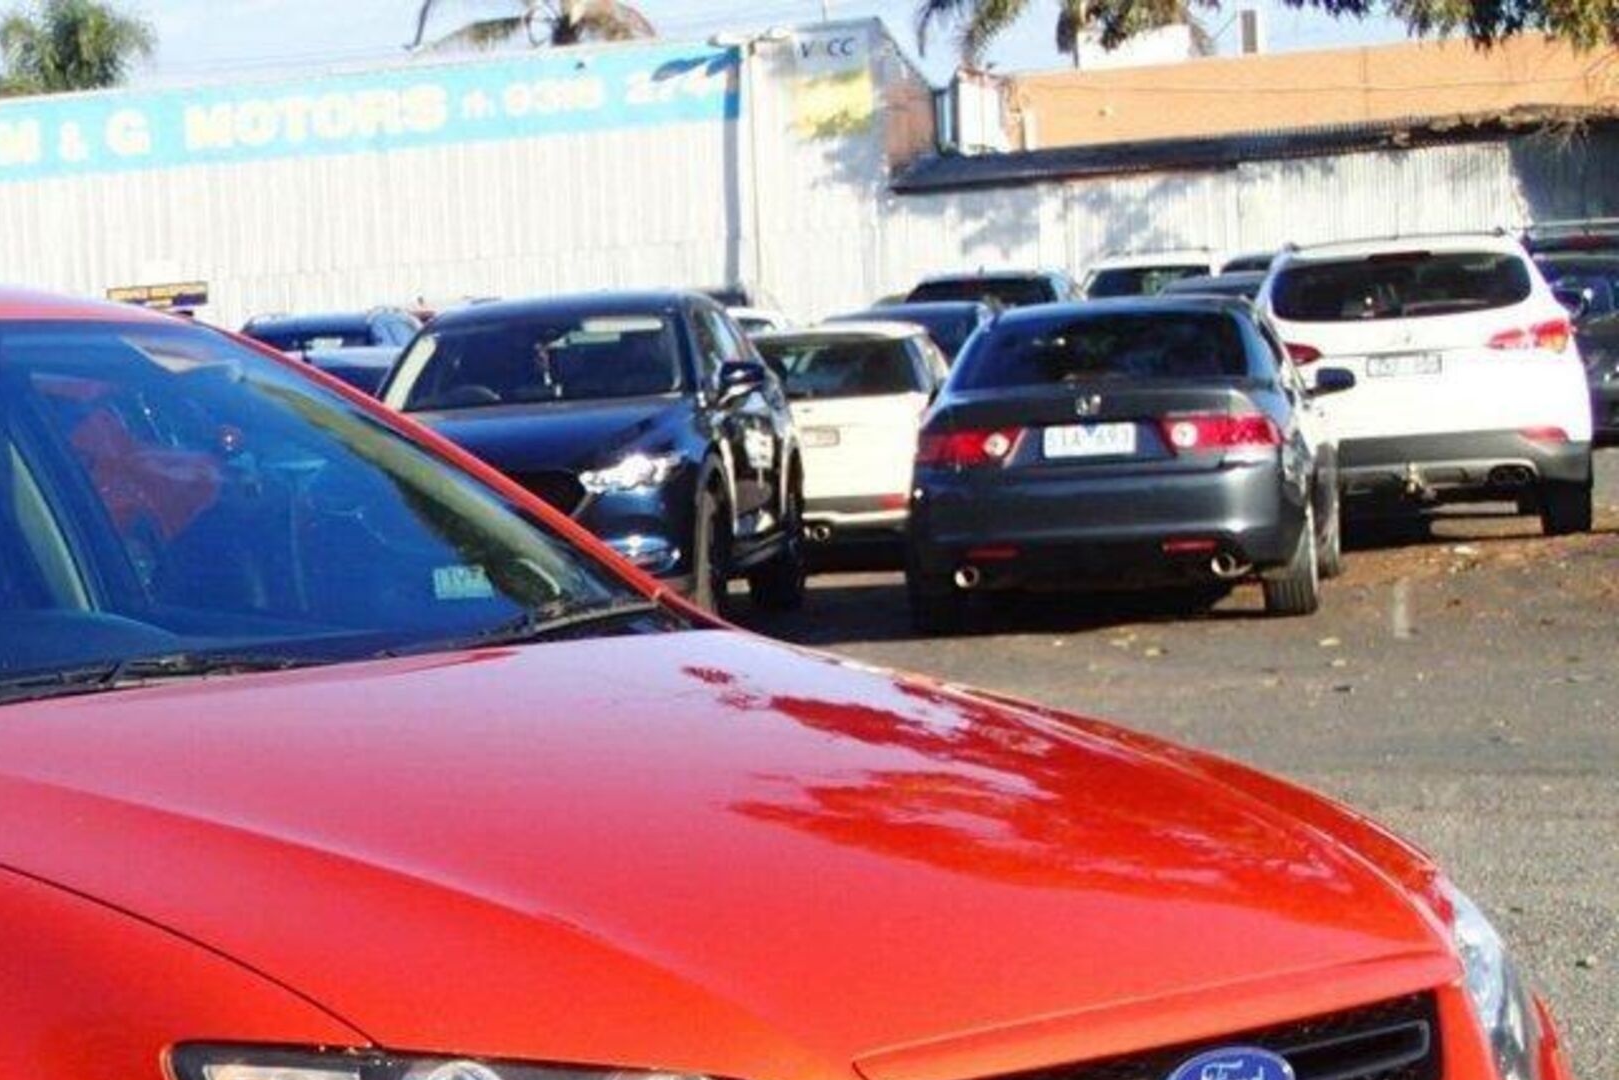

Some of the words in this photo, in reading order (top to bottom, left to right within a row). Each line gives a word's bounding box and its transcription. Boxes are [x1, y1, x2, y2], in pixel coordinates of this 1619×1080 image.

[59, 119, 90, 162] &
[106, 108, 152, 156] G
[184, 83, 447, 150] MOTORS
